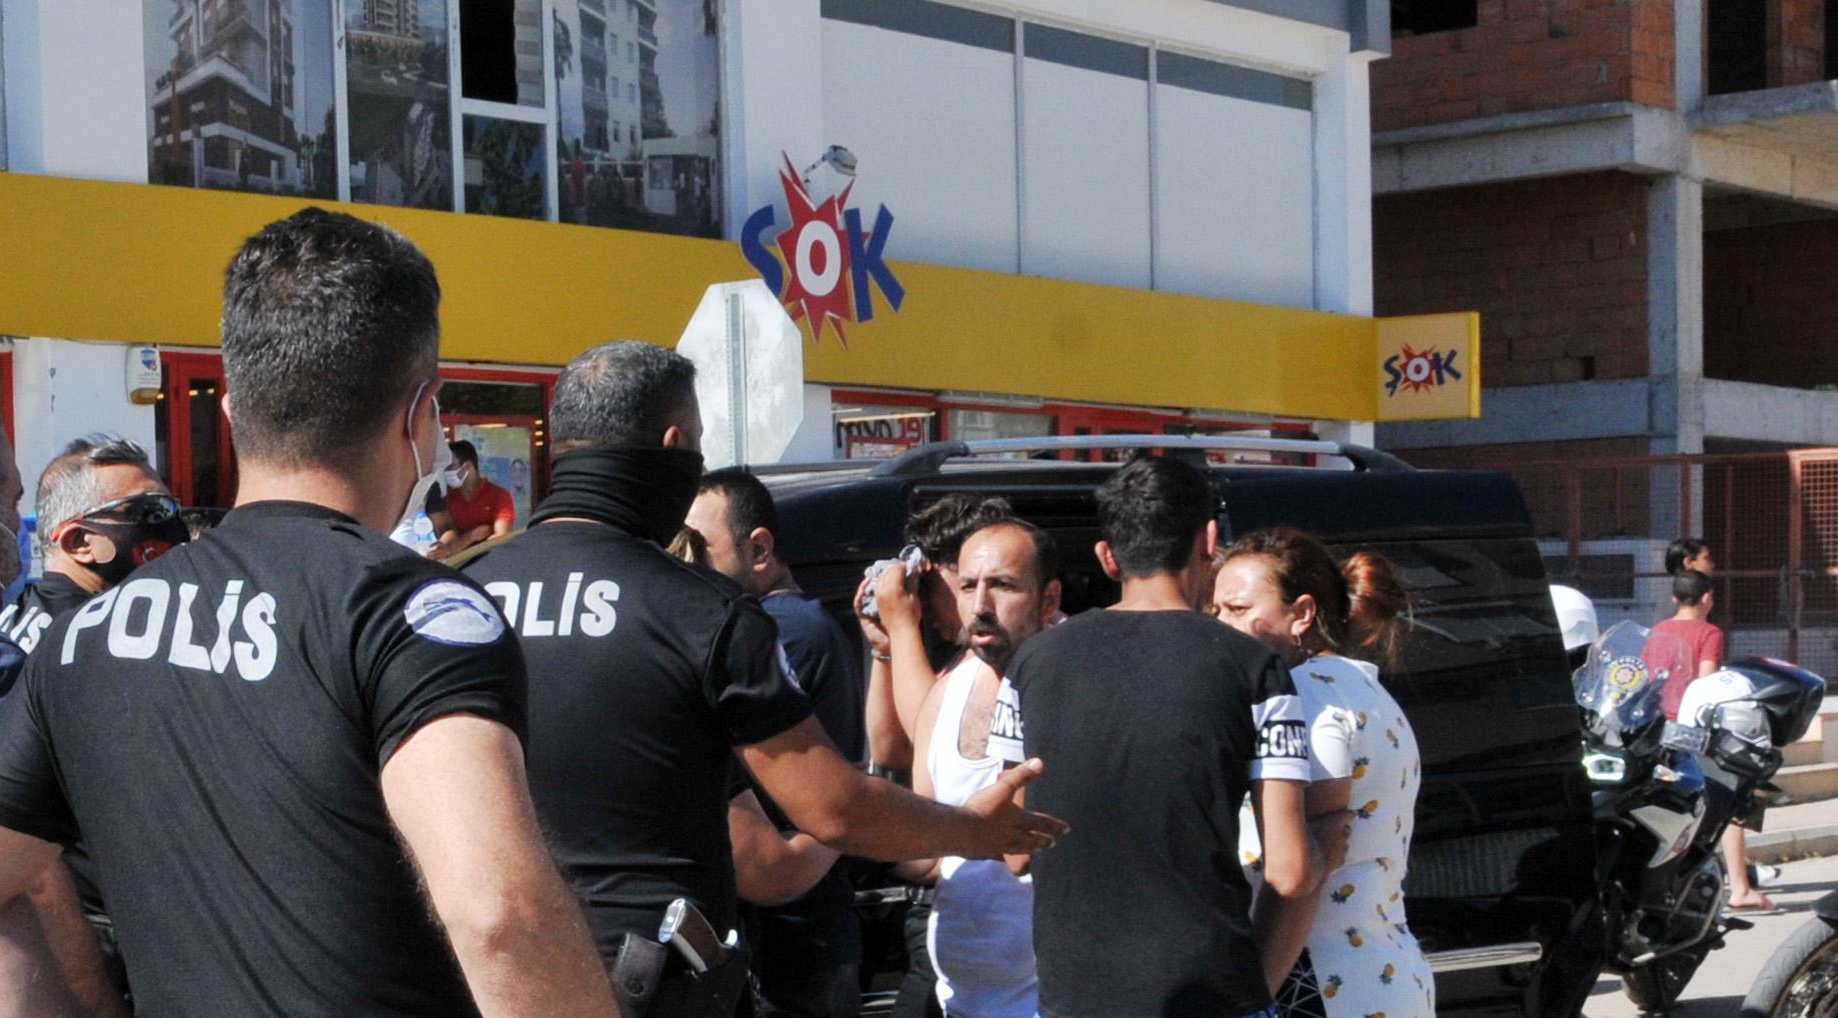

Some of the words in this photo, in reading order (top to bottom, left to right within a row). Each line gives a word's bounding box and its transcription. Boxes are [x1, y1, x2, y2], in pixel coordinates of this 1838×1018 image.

[1383, 347, 1462, 397] ŞOK
[61, 578, 278, 681] POLİS
[484, 572, 621, 637] OLİS
